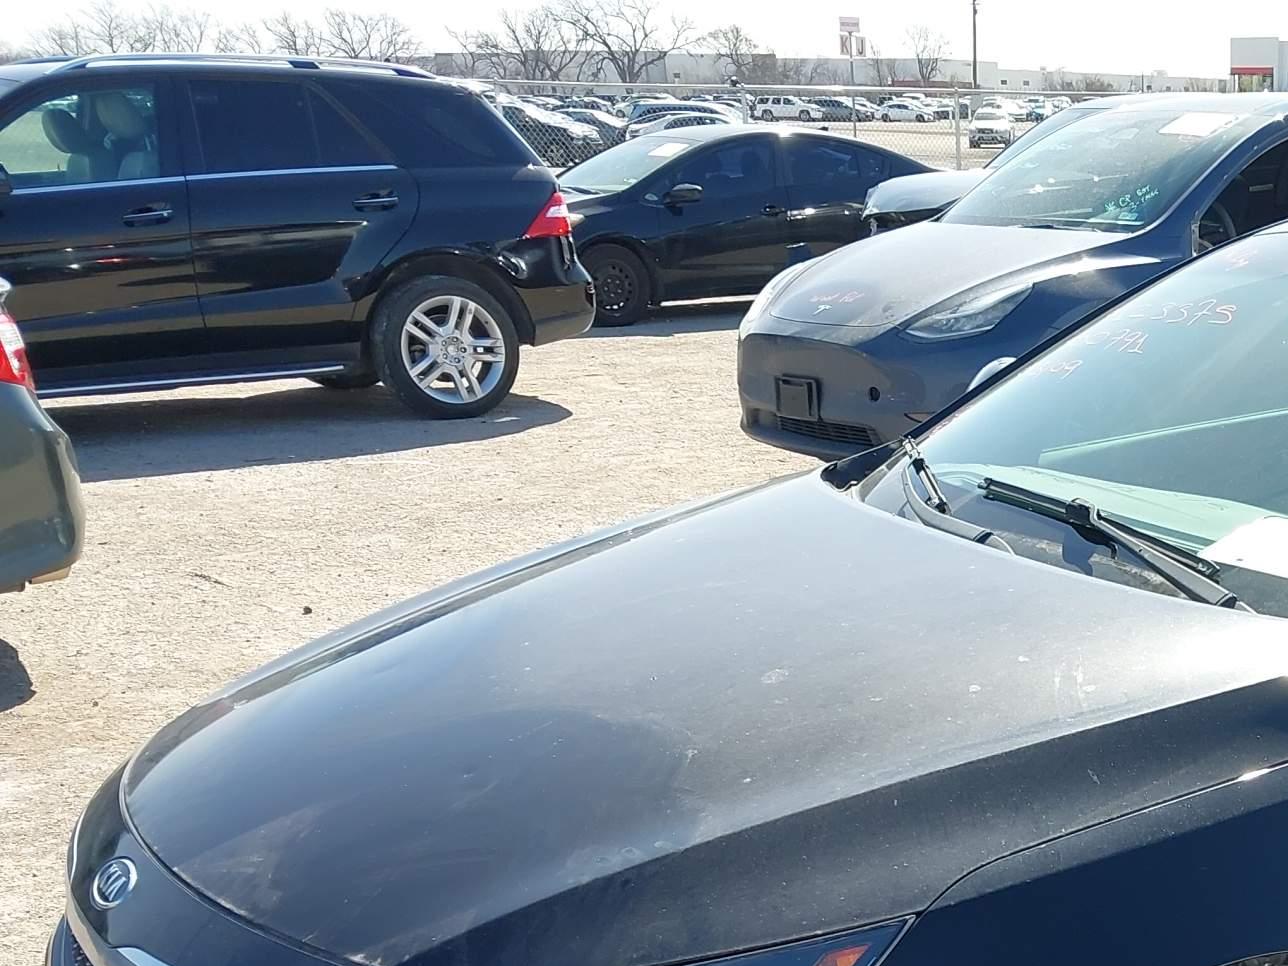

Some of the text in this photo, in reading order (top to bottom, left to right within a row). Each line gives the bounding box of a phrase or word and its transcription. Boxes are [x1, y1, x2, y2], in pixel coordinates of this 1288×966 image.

[841, 35, 864, 55] K J
[97, 861, 131, 904] KIA
